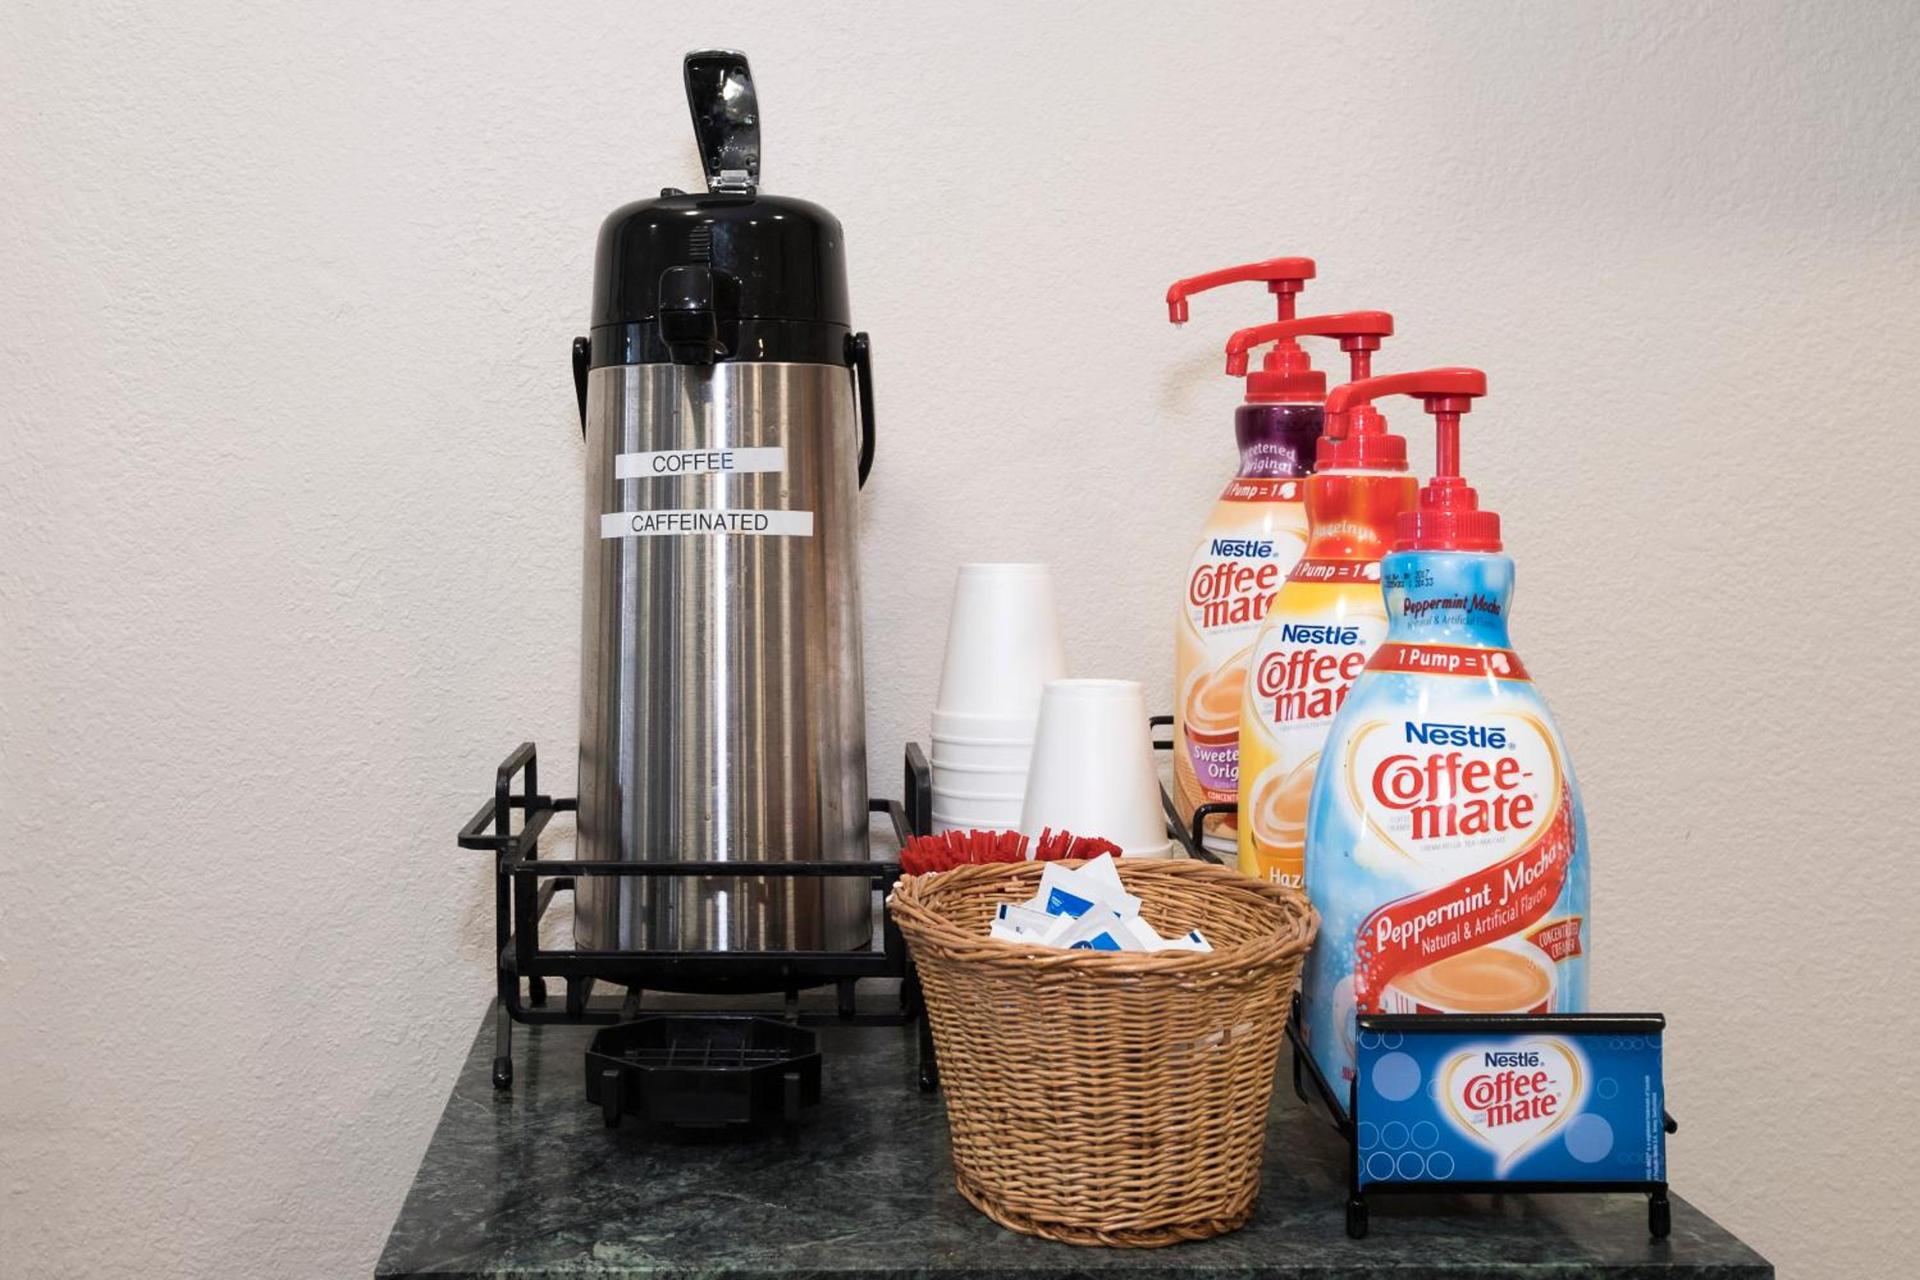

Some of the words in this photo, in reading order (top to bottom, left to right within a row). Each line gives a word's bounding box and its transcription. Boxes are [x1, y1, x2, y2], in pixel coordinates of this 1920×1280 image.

[652, 452, 734, 472] COFFEE
[1271, 484, 1278, 497] 1
[631, 513, 768, 532] CAFFEINATED
[1300, 562, 1336, 580] Pump
[1353, 564, 1361, 578] 1
[1403, 593, 1468, 619] Peppermint
[1257, 648, 1365, 697] Coffee
[1399, 648, 1406, 664] 1
[1409, 648, 1460, 672] Pump
[1465, 657, 1477, 667] =
[1481, 653, 1488, 671] 1
[1274, 683, 1351, 722] mat
[1193, 745, 1239, 762] Sweete
[1208, 763, 1239, 782] Orig
[1410, 793, 1534, 840] mate
[1376, 883, 1492, 952] Peppermint
[1500, 845, 1556, 906] Mocha
[1421, 924, 1460, 957] Natural
[1463, 922, 1472, 940] &
[1475, 901, 1519, 934] Artificial
[1520, 884, 1547, 917] Flavors
[1487, 1094, 1557, 1128] mate
